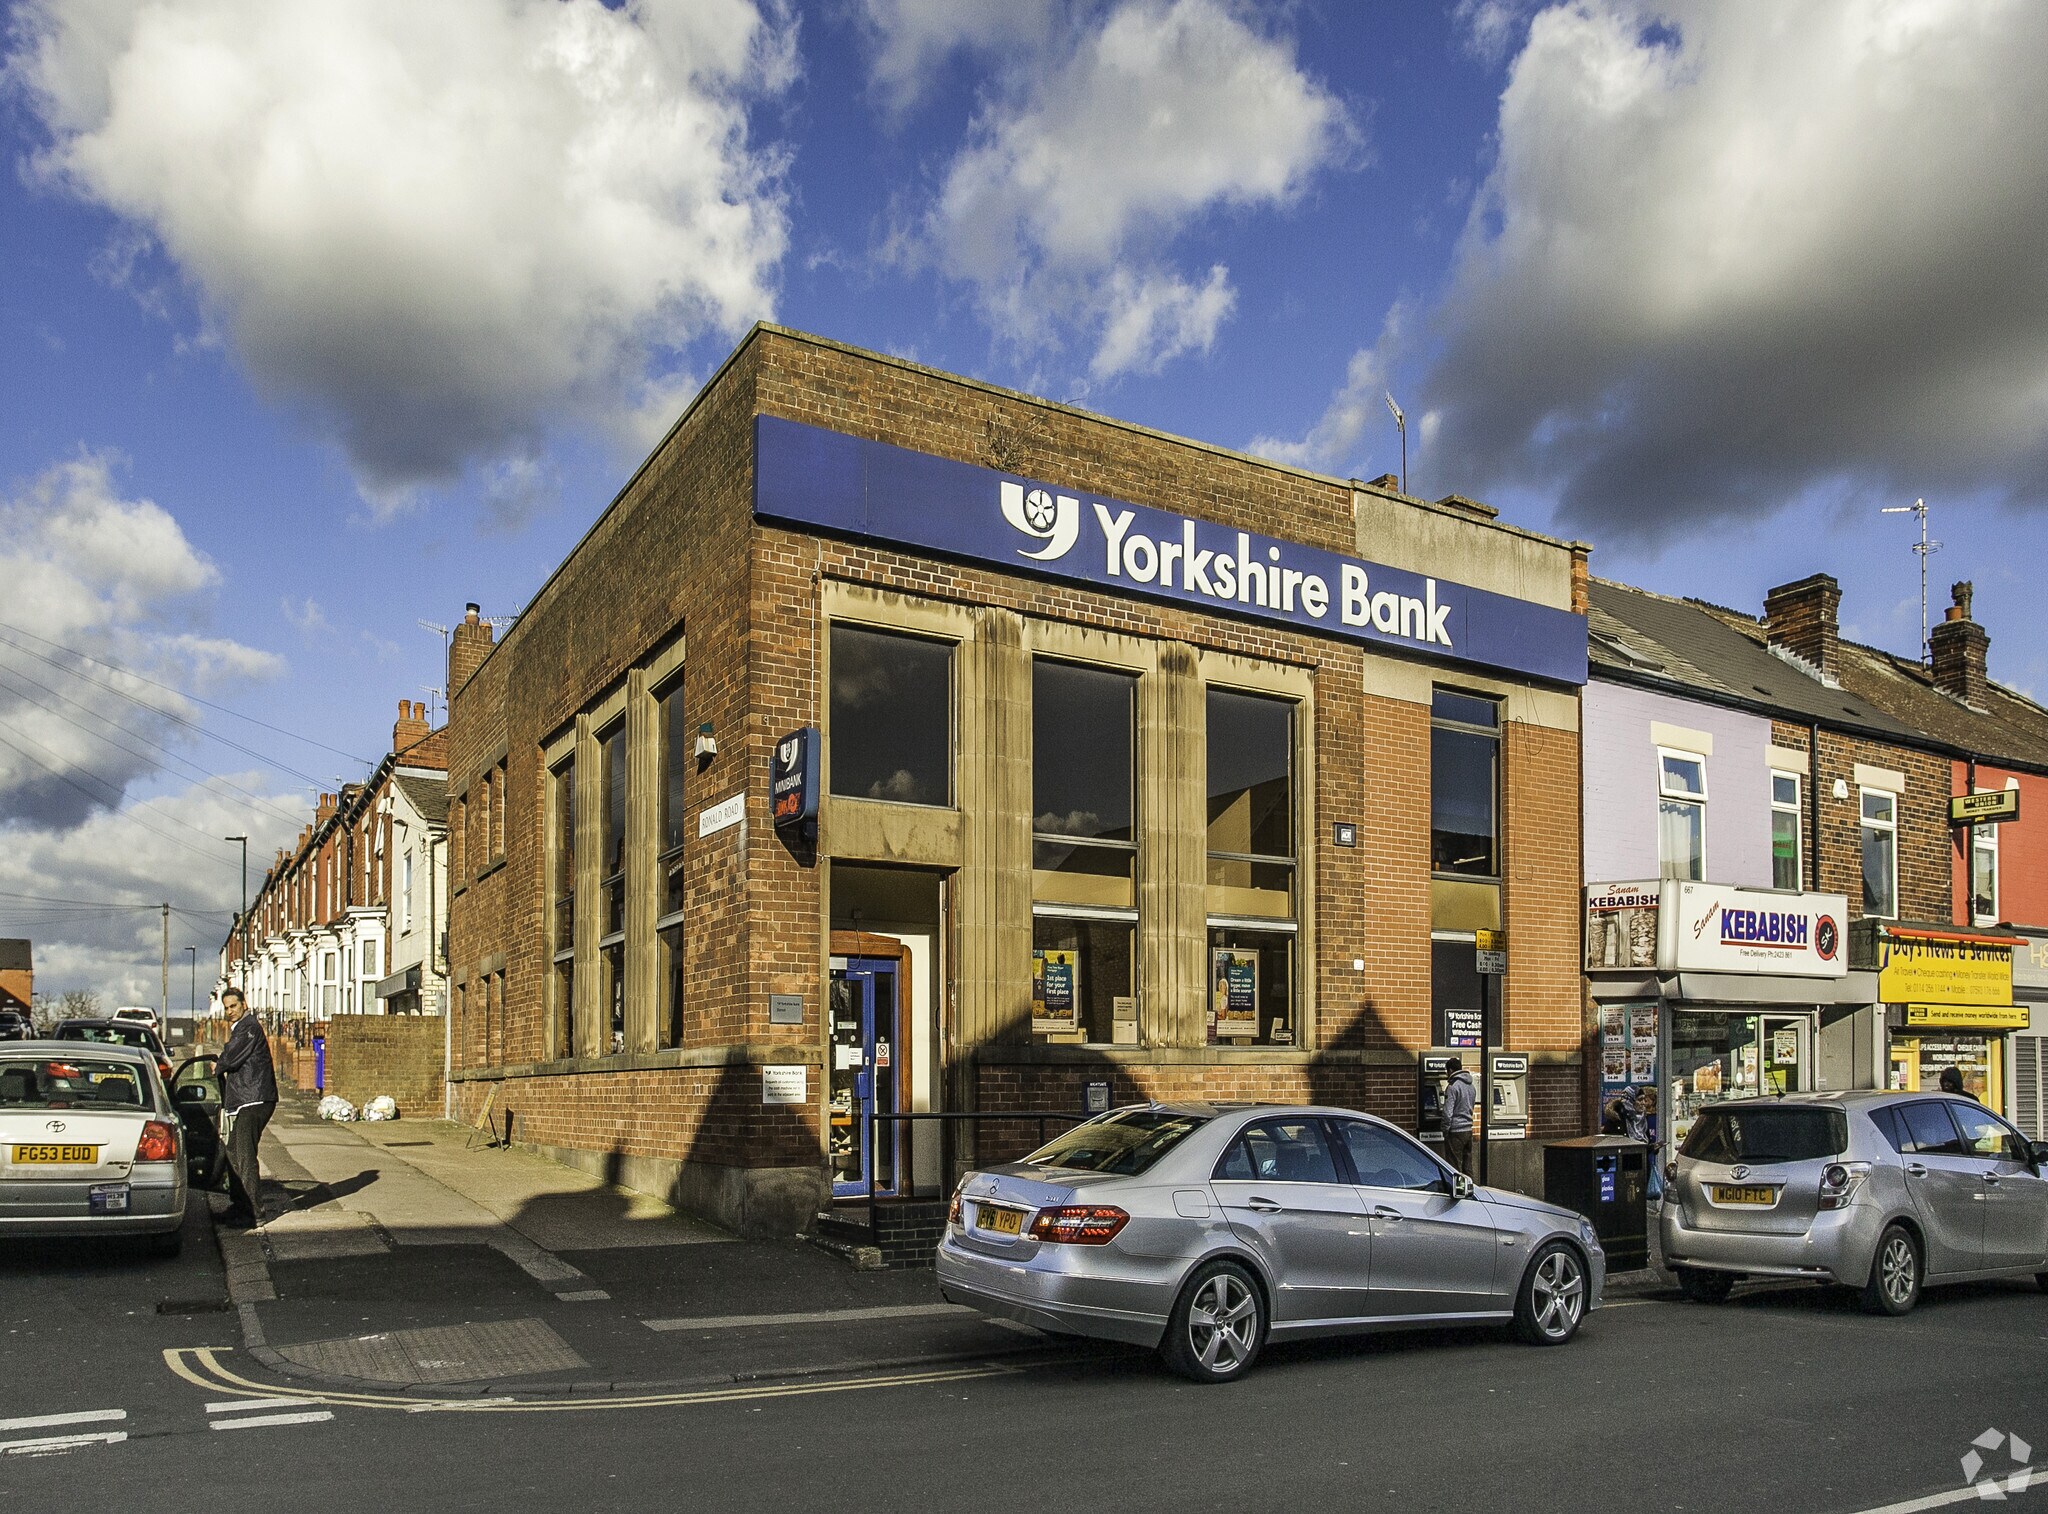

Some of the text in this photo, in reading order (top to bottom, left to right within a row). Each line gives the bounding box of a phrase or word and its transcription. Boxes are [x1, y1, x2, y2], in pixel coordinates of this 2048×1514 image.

[1093, 503, 1452, 647] Yorkshire Bank
[775, 772, 802, 794] MINIBANK
[1964, 796, 1997, 805] WESTERN
[701, 810, 723, 829] RONALD
[724, 802, 740, 820] ROAD
[1607, 885, 1639, 896] Sanam
[1684, 886, 1693, 894] 667
[1589, 894, 1660, 908] KEBABISH
[1693, 900, 1720, 940] Sanam
[1720, 908, 1808, 944] KEBABISH
[1739, 949, 1750, 957] Free
[1750, 950, 1767, 959] Delivery
[1893, 936, 2009, 962] Day's News & Services
[1054, 975, 1067, 983] place
[1917, 967, 1935, 979] Cheque
[1935, 970, 1953, 980] cashing
[1454, 1012, 1474, 1020] Yorkshire
[1931, 1010, 1941, 1018] Send
[1964, 1012, 1977, 1020] money
[1452, 1020, 1482, 1029] Free Cash
[18, 1147, 91, 1161] FG53 EUD
[1744, 1187, 1766, 1201] FTC
